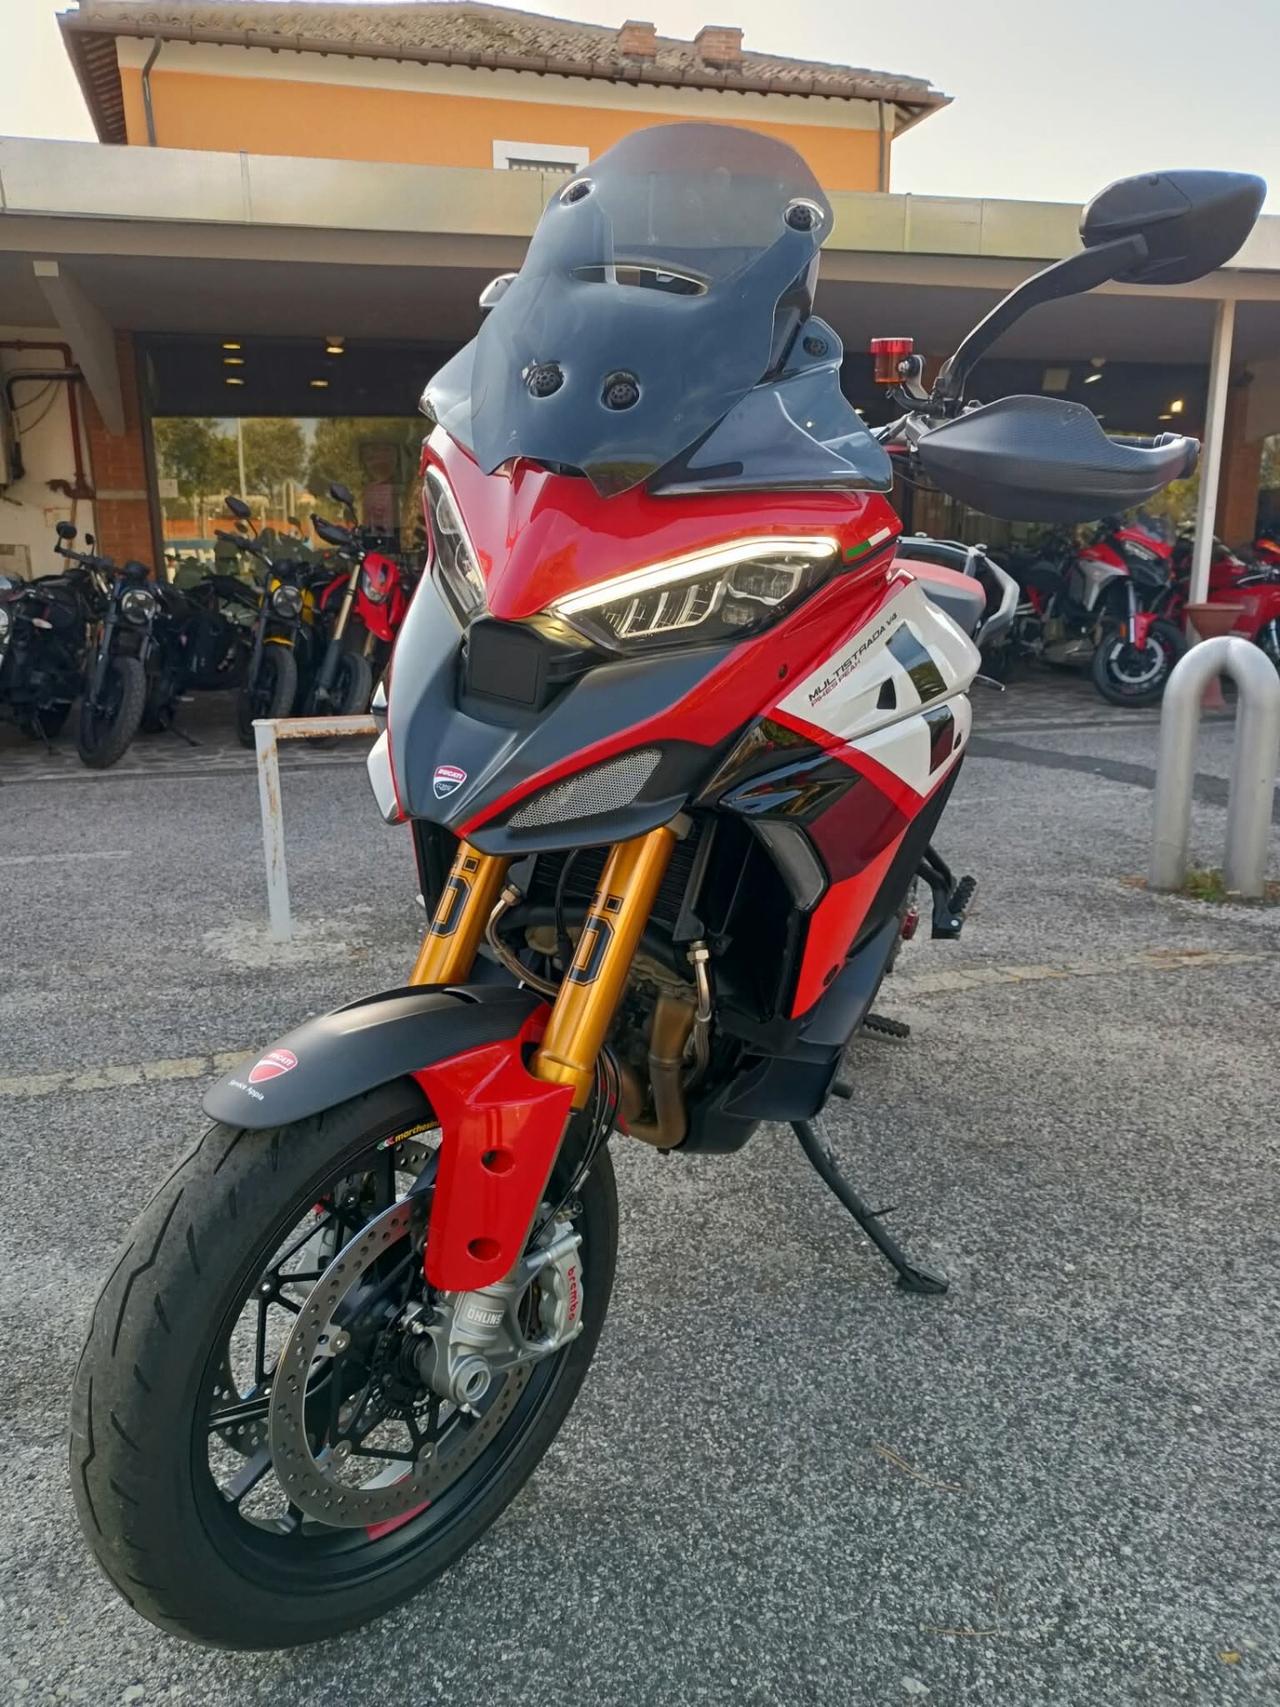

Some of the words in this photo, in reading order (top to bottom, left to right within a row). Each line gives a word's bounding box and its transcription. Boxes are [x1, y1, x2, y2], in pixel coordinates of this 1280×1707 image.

[808, 625, 886, 702] MULTISTRADA
[886, 612, 898, 626] V4
[438, 768, 464, 780] DUCATI
[567, 1264, 580, 1321] brembo
